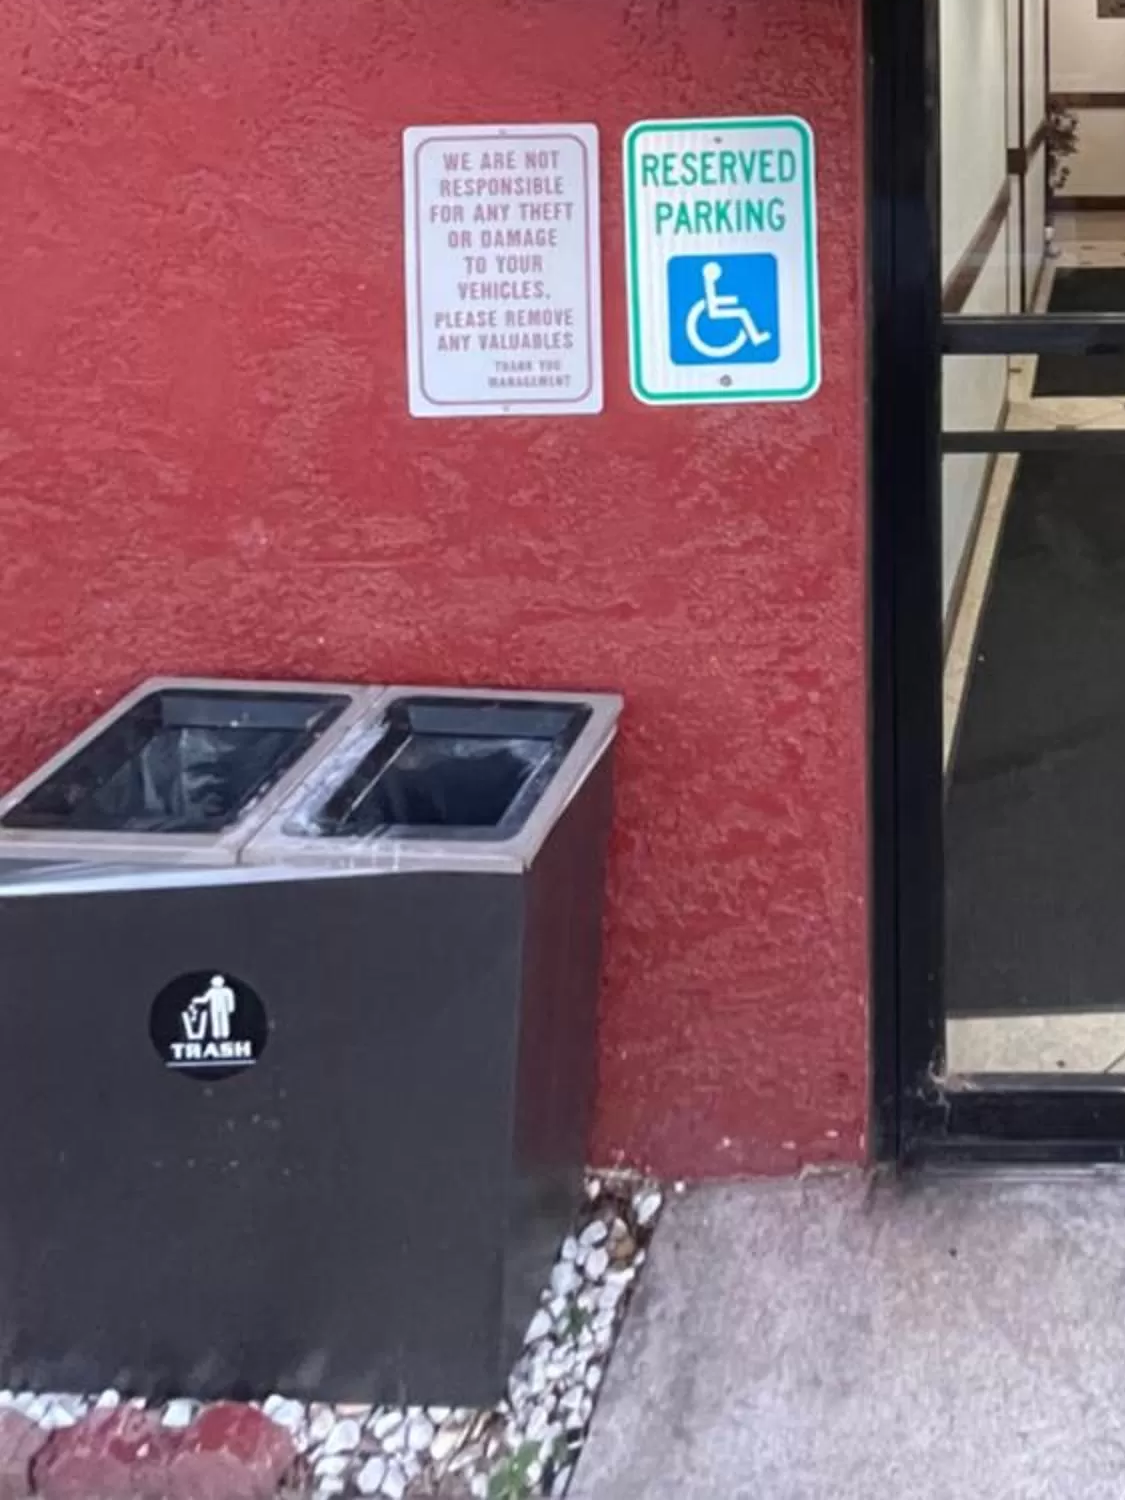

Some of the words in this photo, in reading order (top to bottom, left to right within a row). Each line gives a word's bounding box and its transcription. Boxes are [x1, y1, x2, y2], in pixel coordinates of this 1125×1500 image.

[443, 152, 472, 171] WE
[480, 150, 516, 170] ARE
[524, 150, 560, 169] NOT
[641, 149, 797, 187] RESERVED
[440, 176, 564, 197] RESPONSIBLE
[430, 204, 464, 223] FOR
[473, 203, 510, 224] ANY
[519, 202, 574, 221] THEFT
[655, 197, 787, 235] PARKING
[447, 230, 472, 248] OR
[481, 228, 558, 249] DAMAGE
[463, 256, 487, 274] TO
[496, 255, 543, 274] YOUR
[457, 280, 552, 301] VEHICLES.
[434, 310, 497, 329] PLEASE
[504, 308, 574, 327] REMOVE
[437, 334, 471, 351] ANY
[478, 332, 574, 351] VALUABLES
[169, 1041, 252, 1060] TRASH
